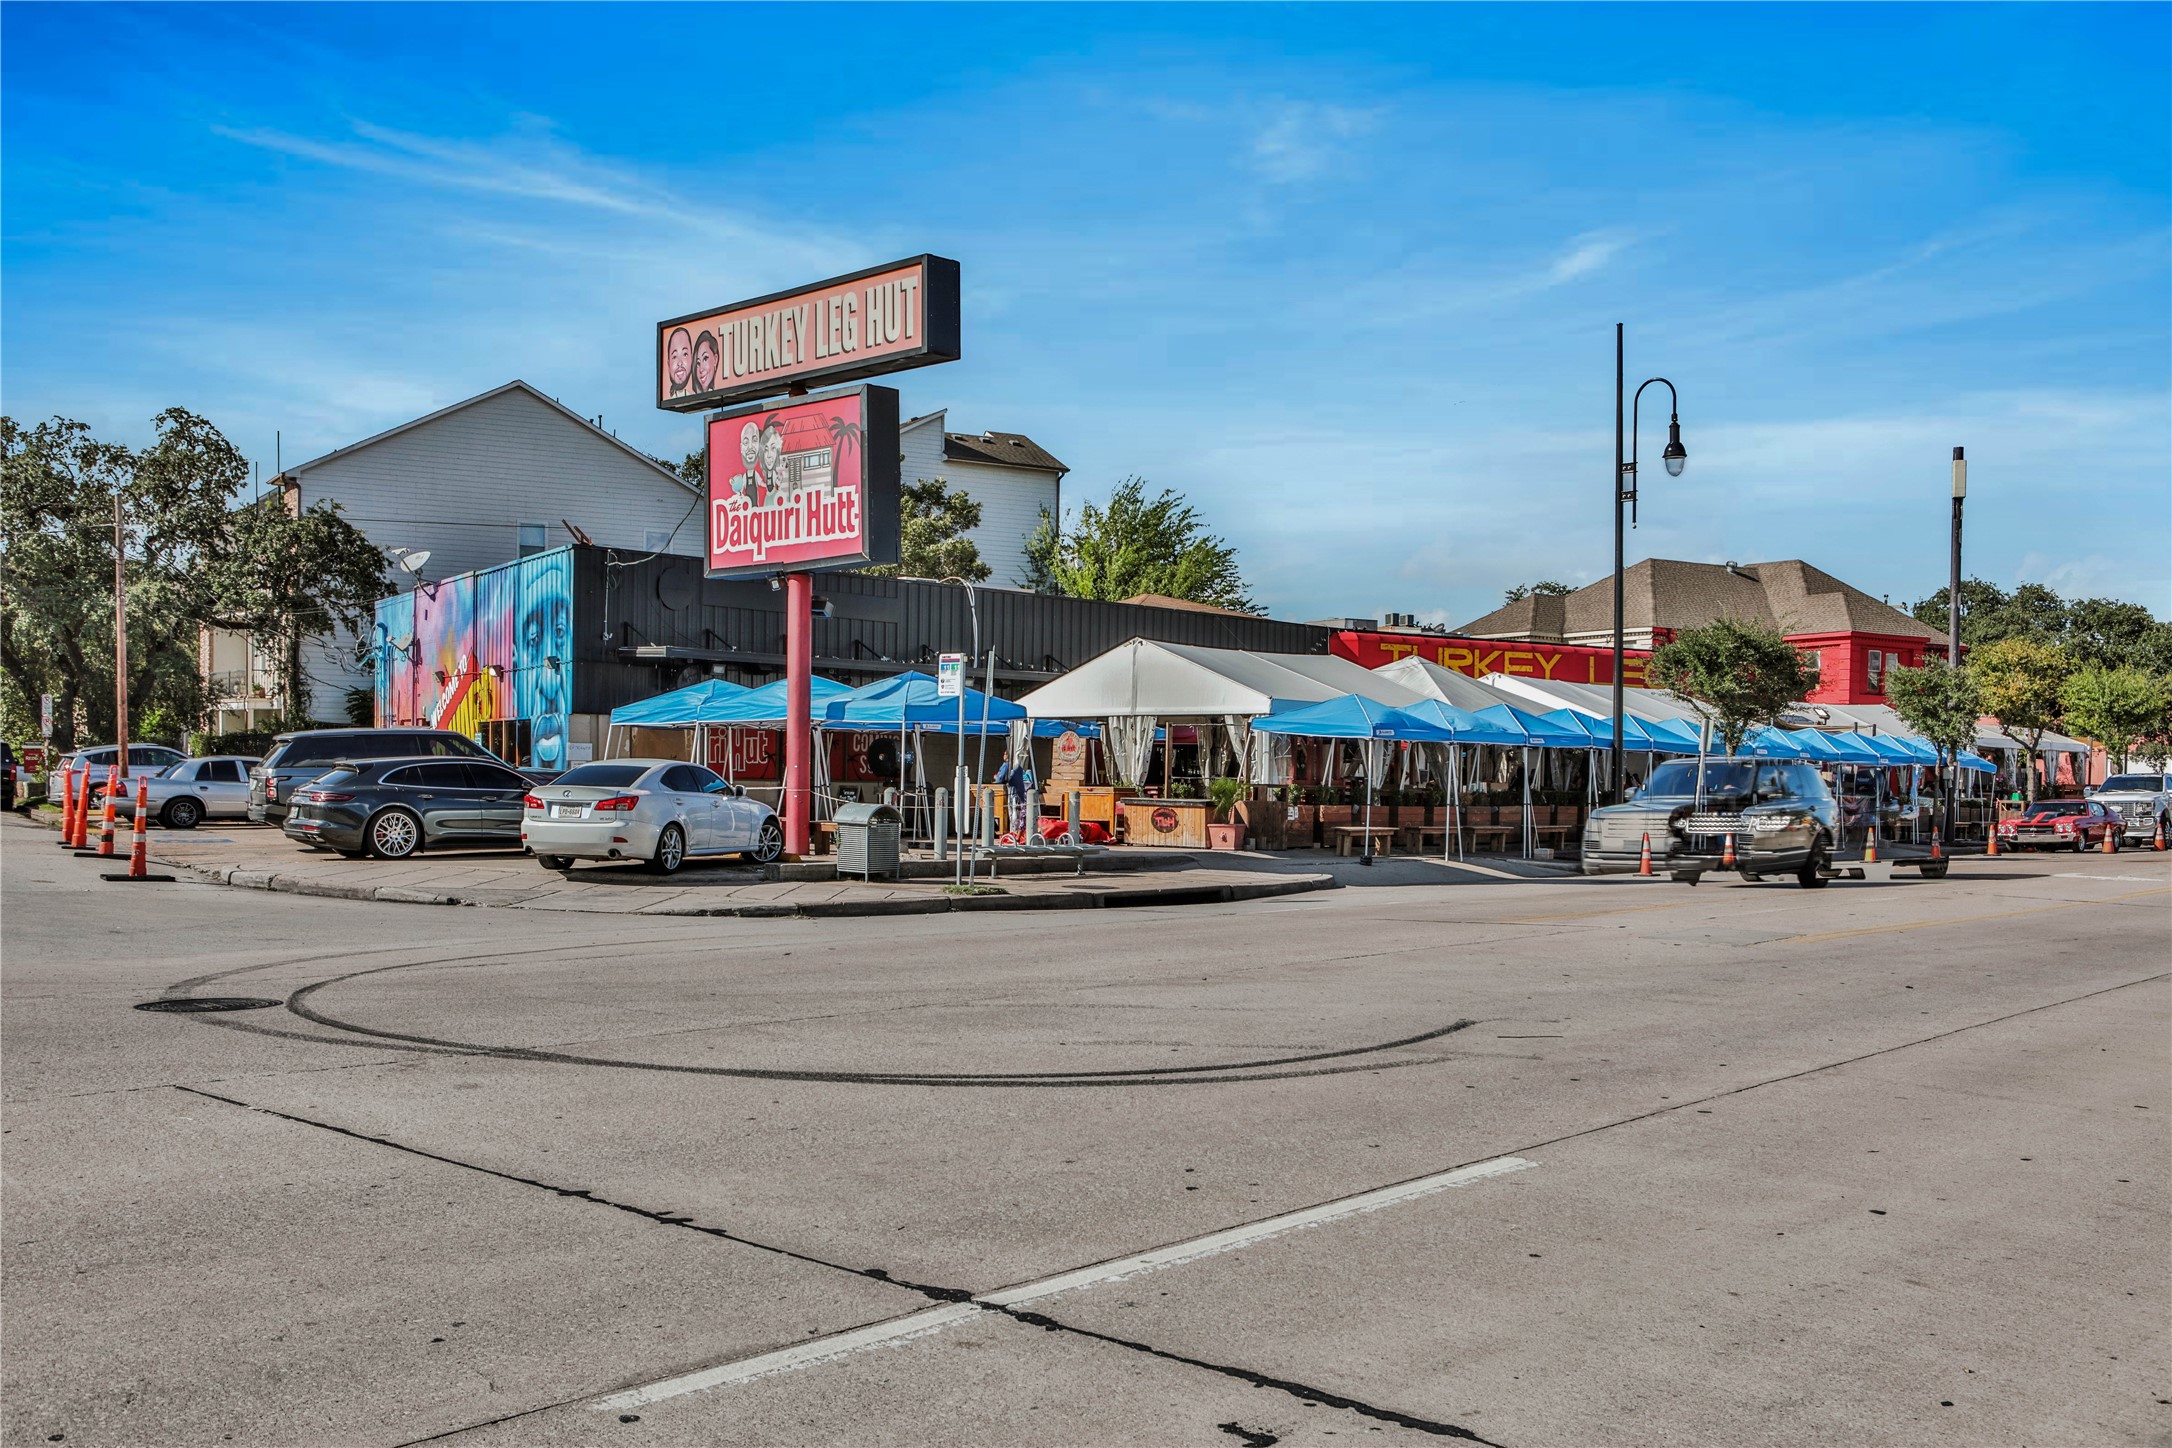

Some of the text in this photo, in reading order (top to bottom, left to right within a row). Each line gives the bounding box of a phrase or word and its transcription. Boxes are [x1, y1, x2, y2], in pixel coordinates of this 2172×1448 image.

[718, 275, 918, 380] TURKEY LEG HUT
[716, 489, 856, 556] Daiquiri Hutt
[729, 500, 742, 513] the
[430, 654, 468, 731] WELCOME TO
[731, 728, 769, 772] Hut
